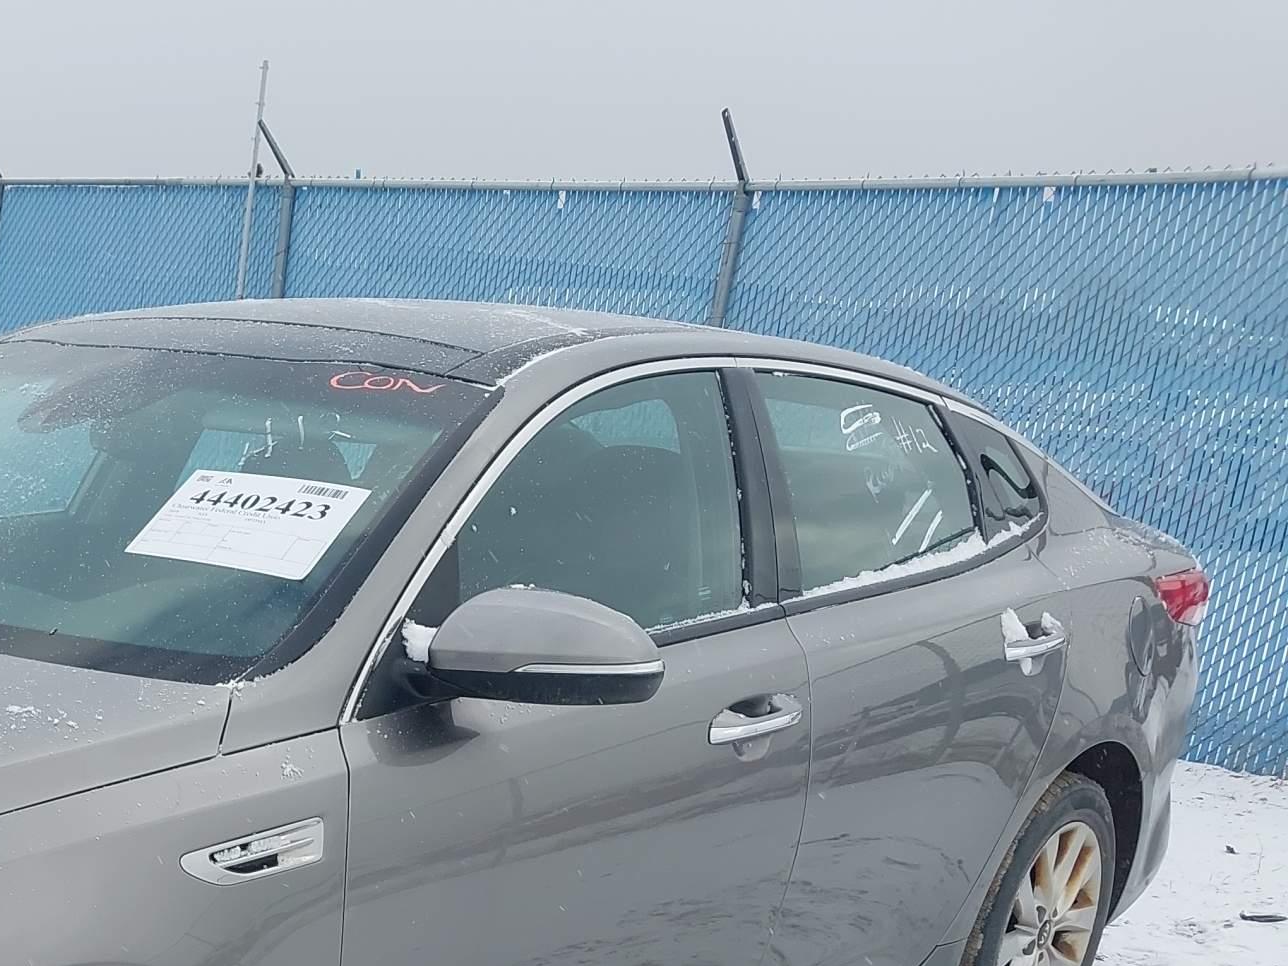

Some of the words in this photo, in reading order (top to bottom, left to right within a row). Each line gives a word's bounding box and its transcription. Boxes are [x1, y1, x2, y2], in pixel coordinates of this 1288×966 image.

[329, 371, 447, 393] CON
[892, 416, 939, 453] #12
[189, 489, 331, 520] 44402423
